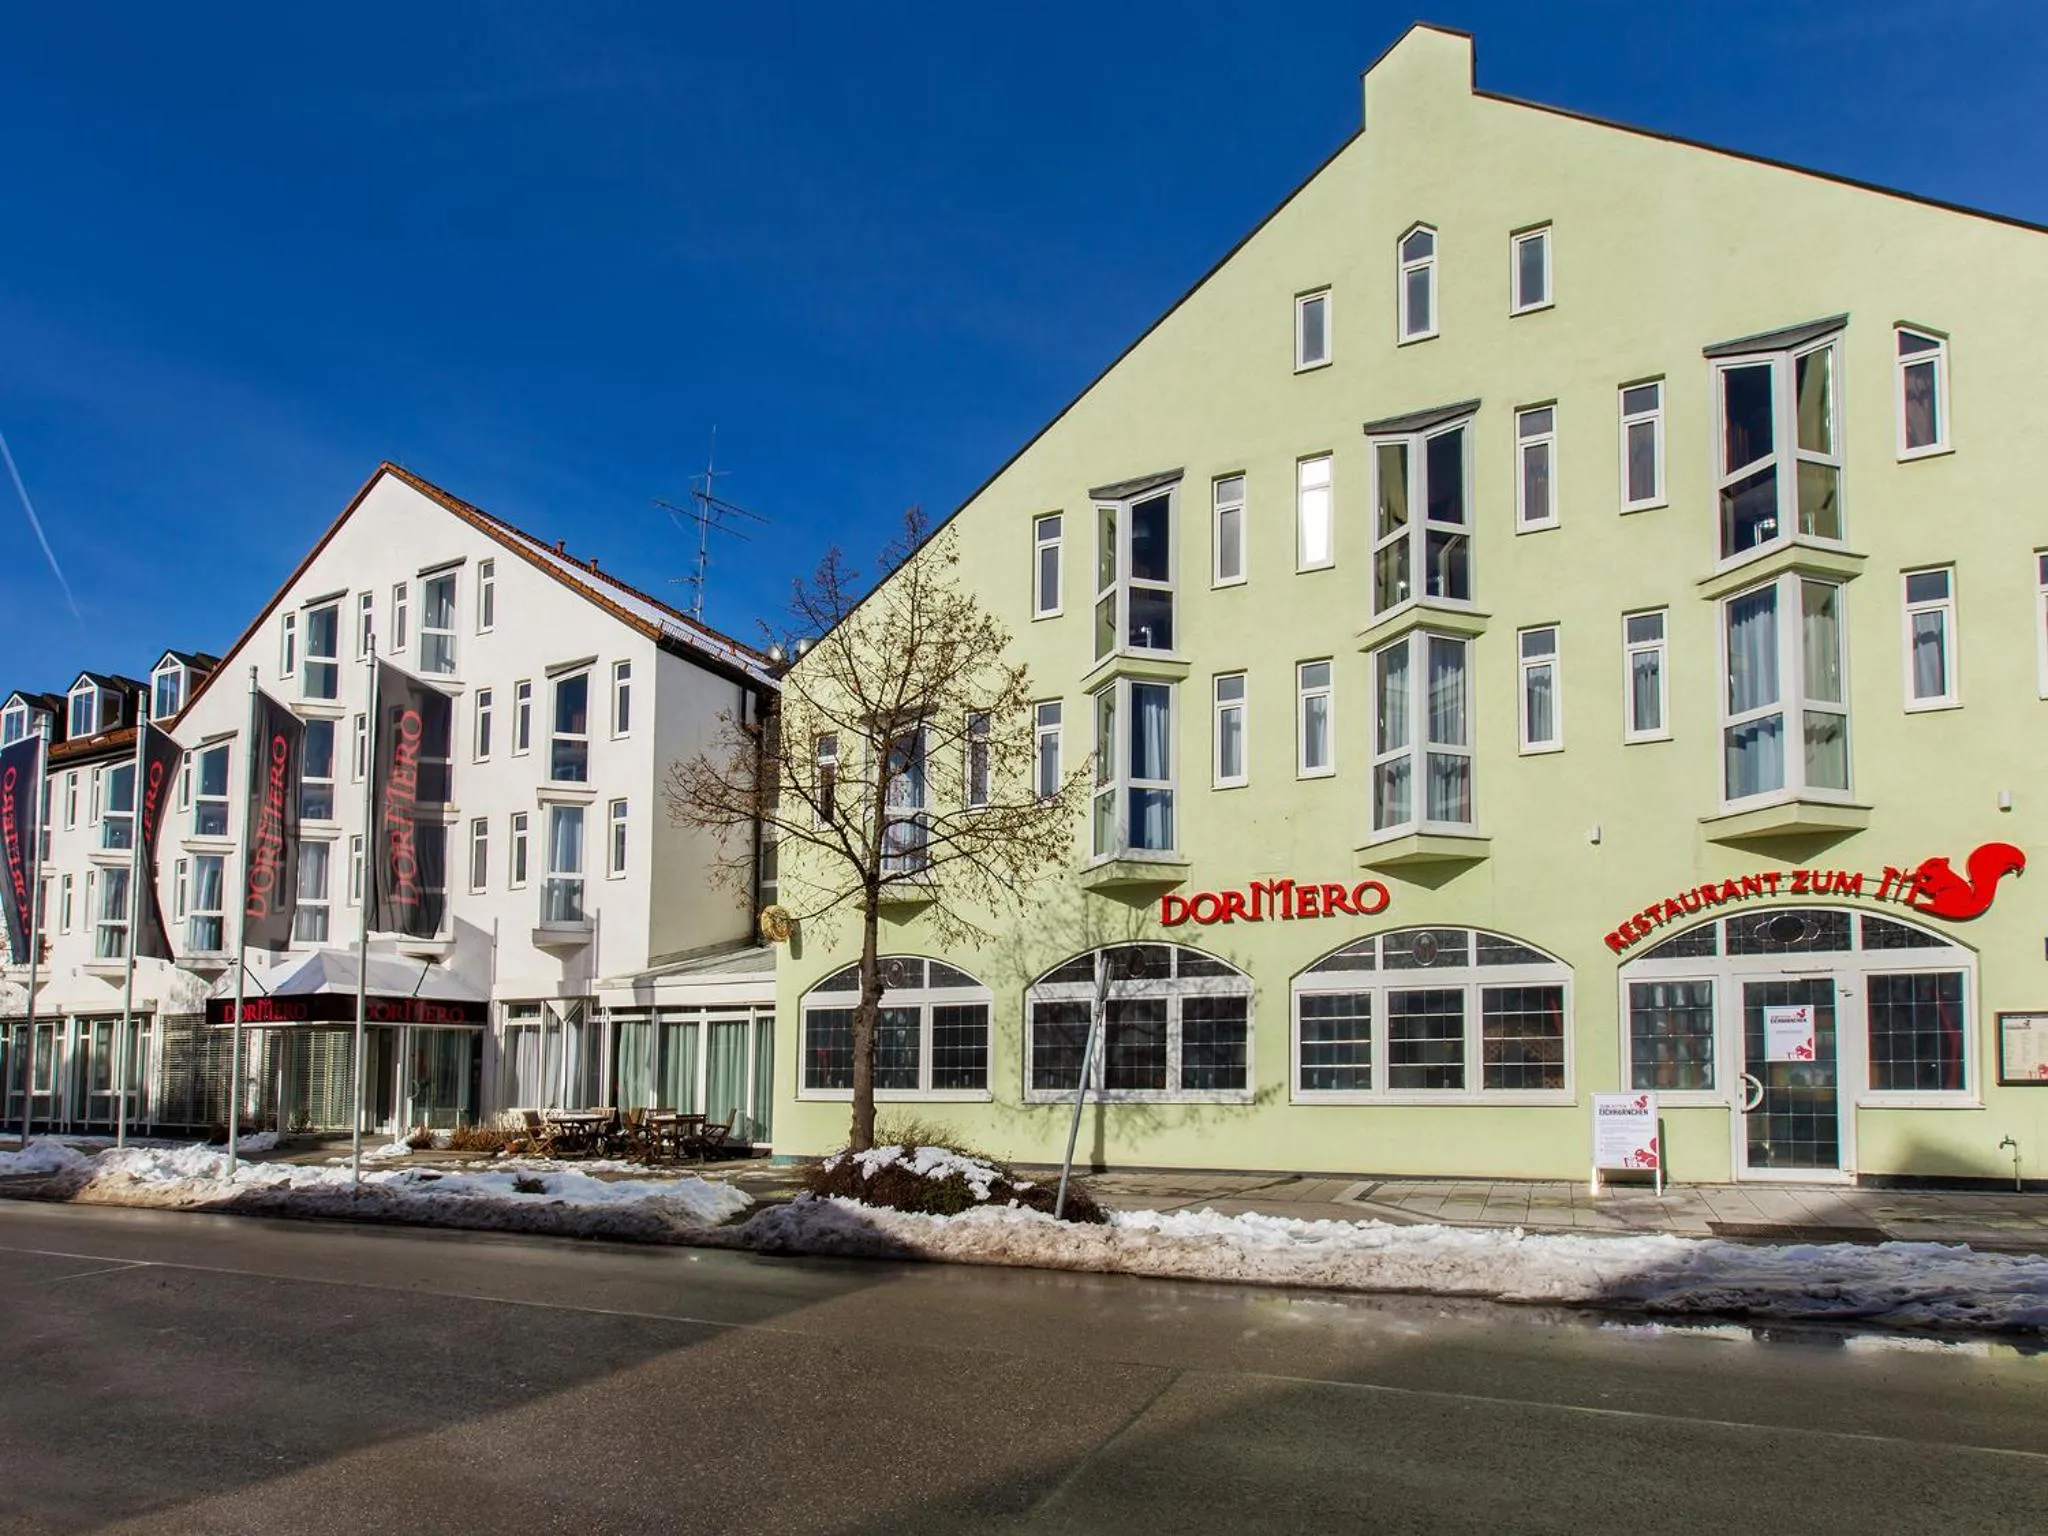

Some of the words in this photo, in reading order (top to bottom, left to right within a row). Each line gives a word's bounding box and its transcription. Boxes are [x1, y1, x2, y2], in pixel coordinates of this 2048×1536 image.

[246, 733, 288, 919] DORMERO
[385, 708, 422, 906] DORMERO
[1160, 878, 1391, 927] DORMERO
[1603, 870, 1783, 956] RESTAURANT
[1790, 869, 1864, 899] ZUM
